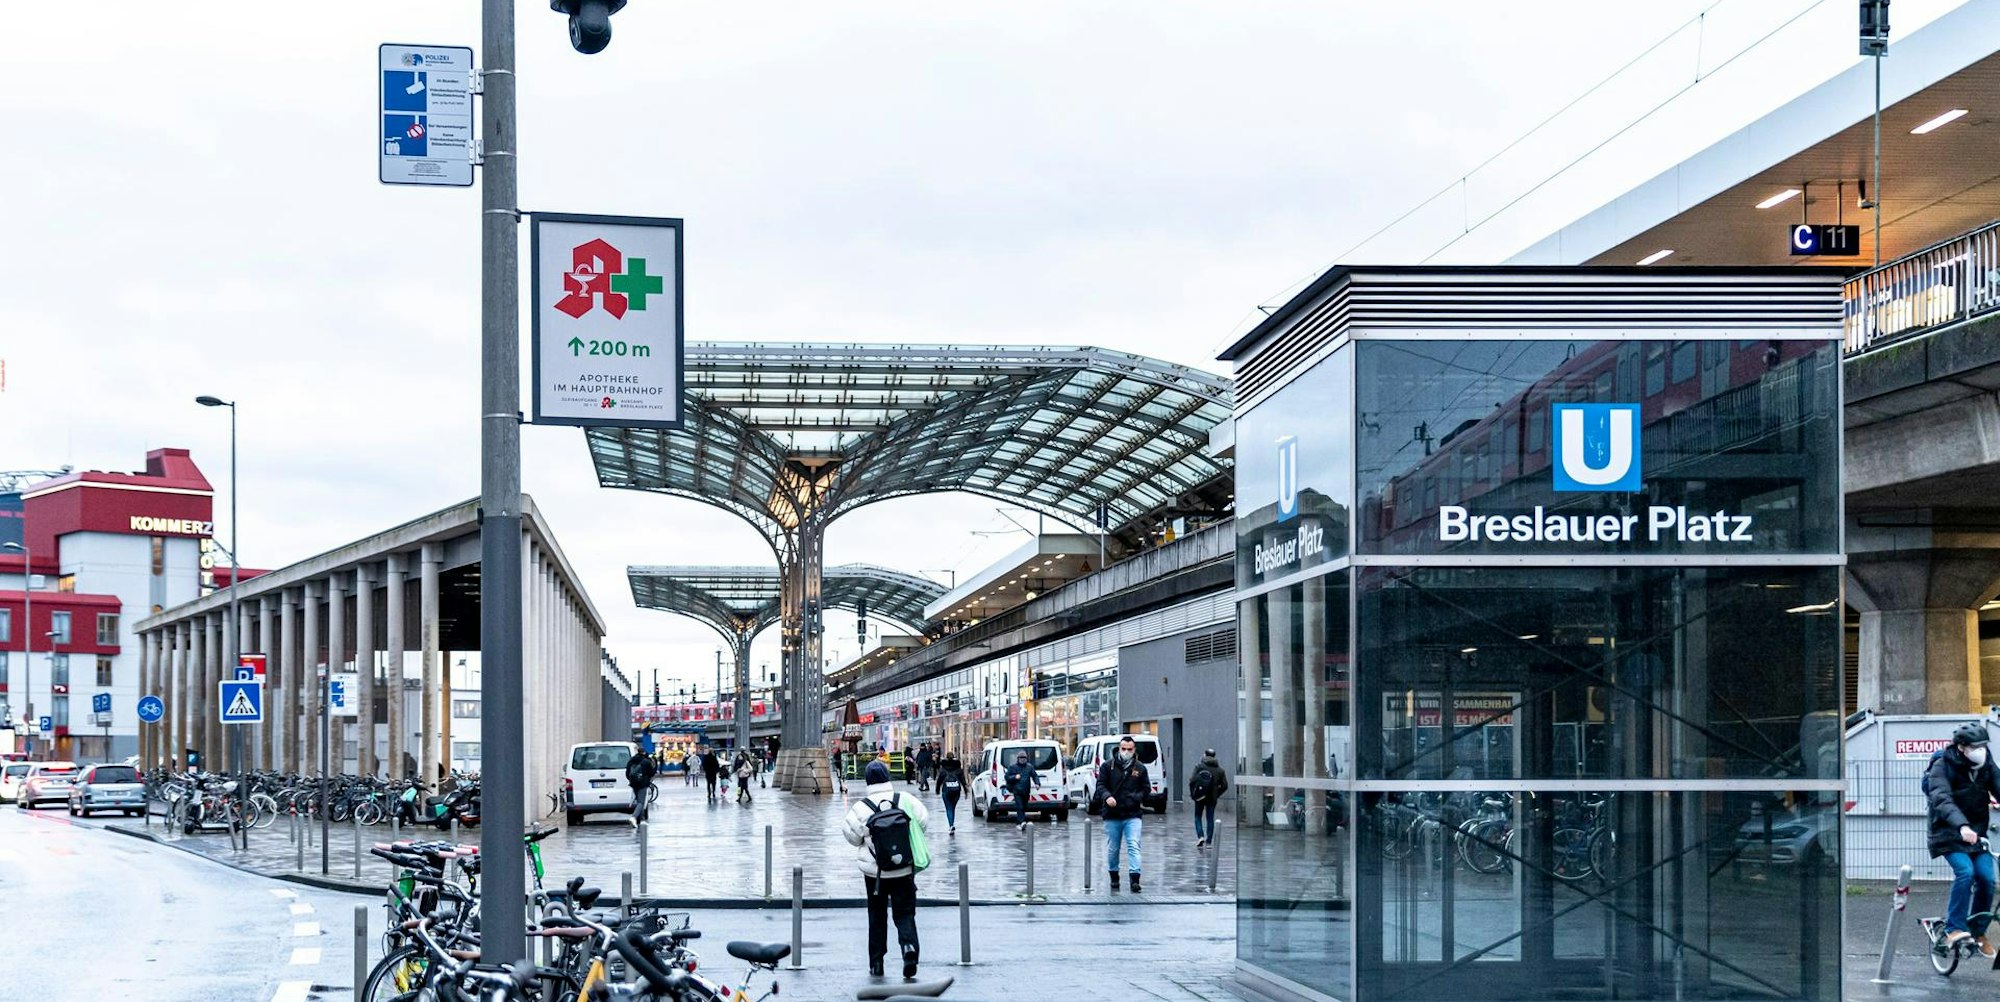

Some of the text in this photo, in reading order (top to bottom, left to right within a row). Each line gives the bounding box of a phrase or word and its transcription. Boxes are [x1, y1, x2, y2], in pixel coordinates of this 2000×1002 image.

[1794, 225, 1846, 249] C 11
[589, 340, 650, 357] 200 m
[553, 384, 664, 395] IM HAUPTBAHNHOF
[579, 374, 639, 384] APOTHEKE
[1561, 409, 1632, 485] U
[1279, 442, 1296, 514] U
[130, 516, 213, 534] KOMMERZ
[1439, 506, 1752, 541] Breslauer Platz
[1255, 524, 1323, 574] Breslauer Platz
[1469, 713, 1514, 725] MÖICH
